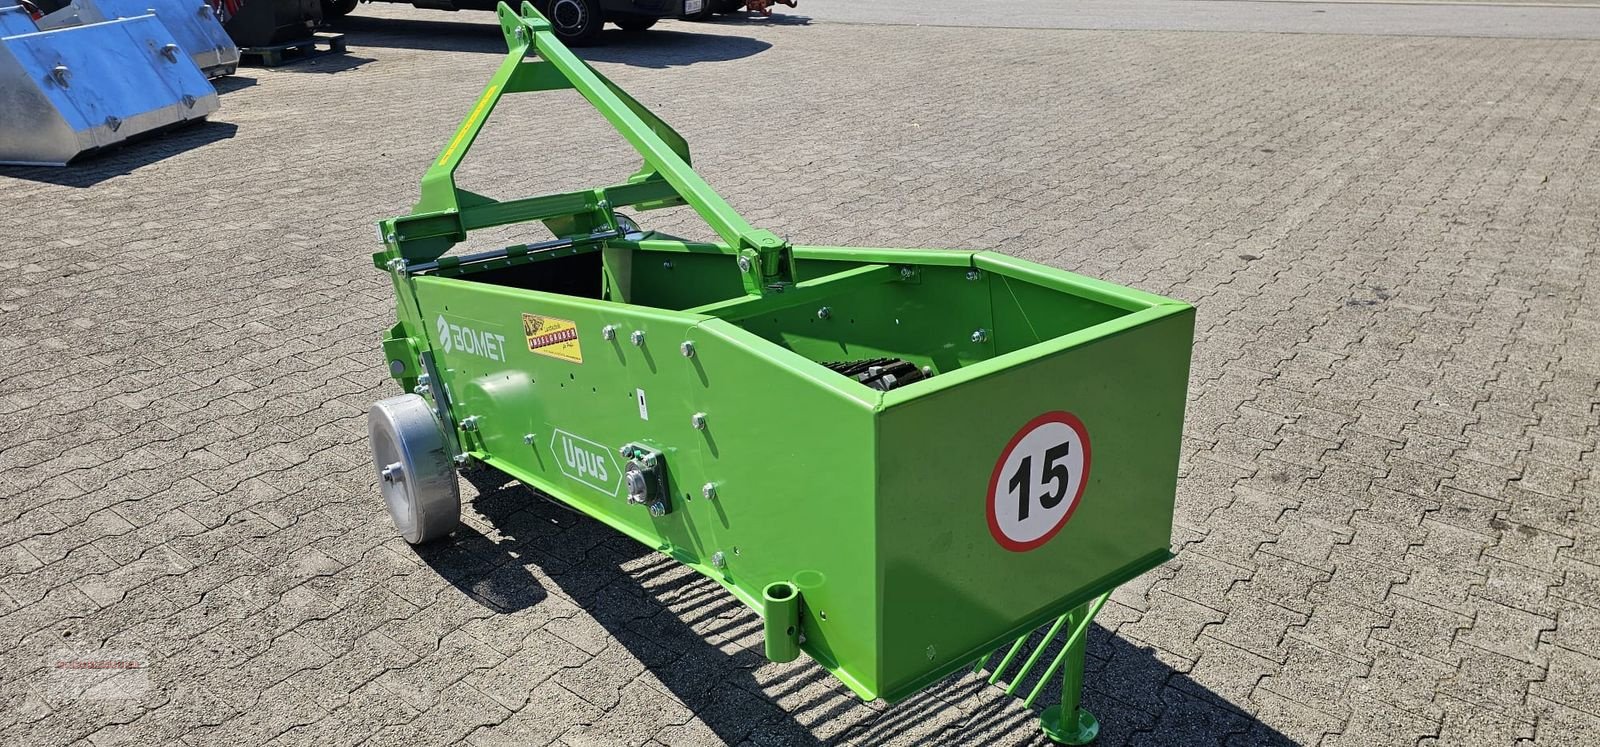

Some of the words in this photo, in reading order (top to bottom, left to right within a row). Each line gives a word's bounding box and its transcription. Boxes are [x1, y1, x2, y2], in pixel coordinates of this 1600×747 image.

[450, 324, 506, 362] BOMET
[562, 437, 608, 482] Upus
[1008, 441, 1070, 522] 15
